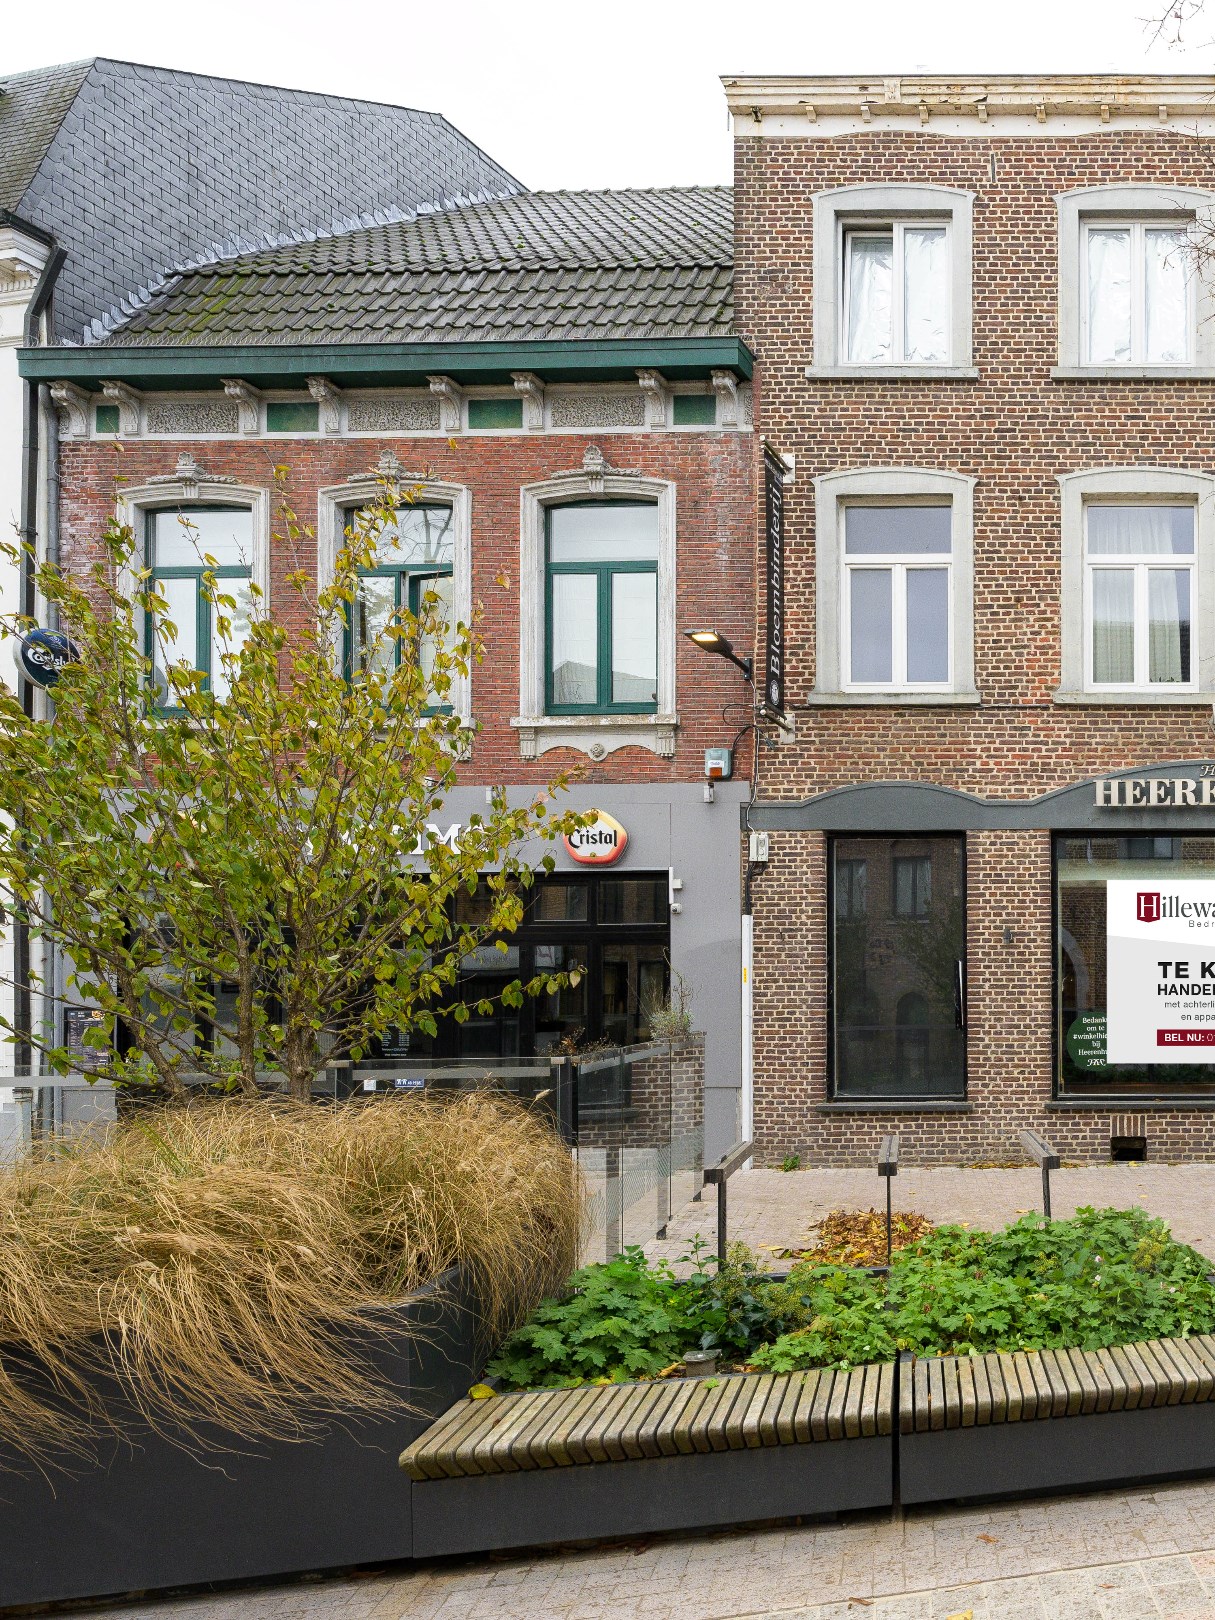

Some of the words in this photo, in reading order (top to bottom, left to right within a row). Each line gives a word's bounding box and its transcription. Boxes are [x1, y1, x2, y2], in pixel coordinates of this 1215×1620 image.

[769, 483, 782, 679] Bloembinderij
[568, 829, 617, 848] Cristal
[1157, 961, 1190, 979] TE
[1091, 1040, 1101, 1048] bij
[1164, 1033, 1184, 1042] BEL
[1186, 1033, 1205, 1042] NU:
